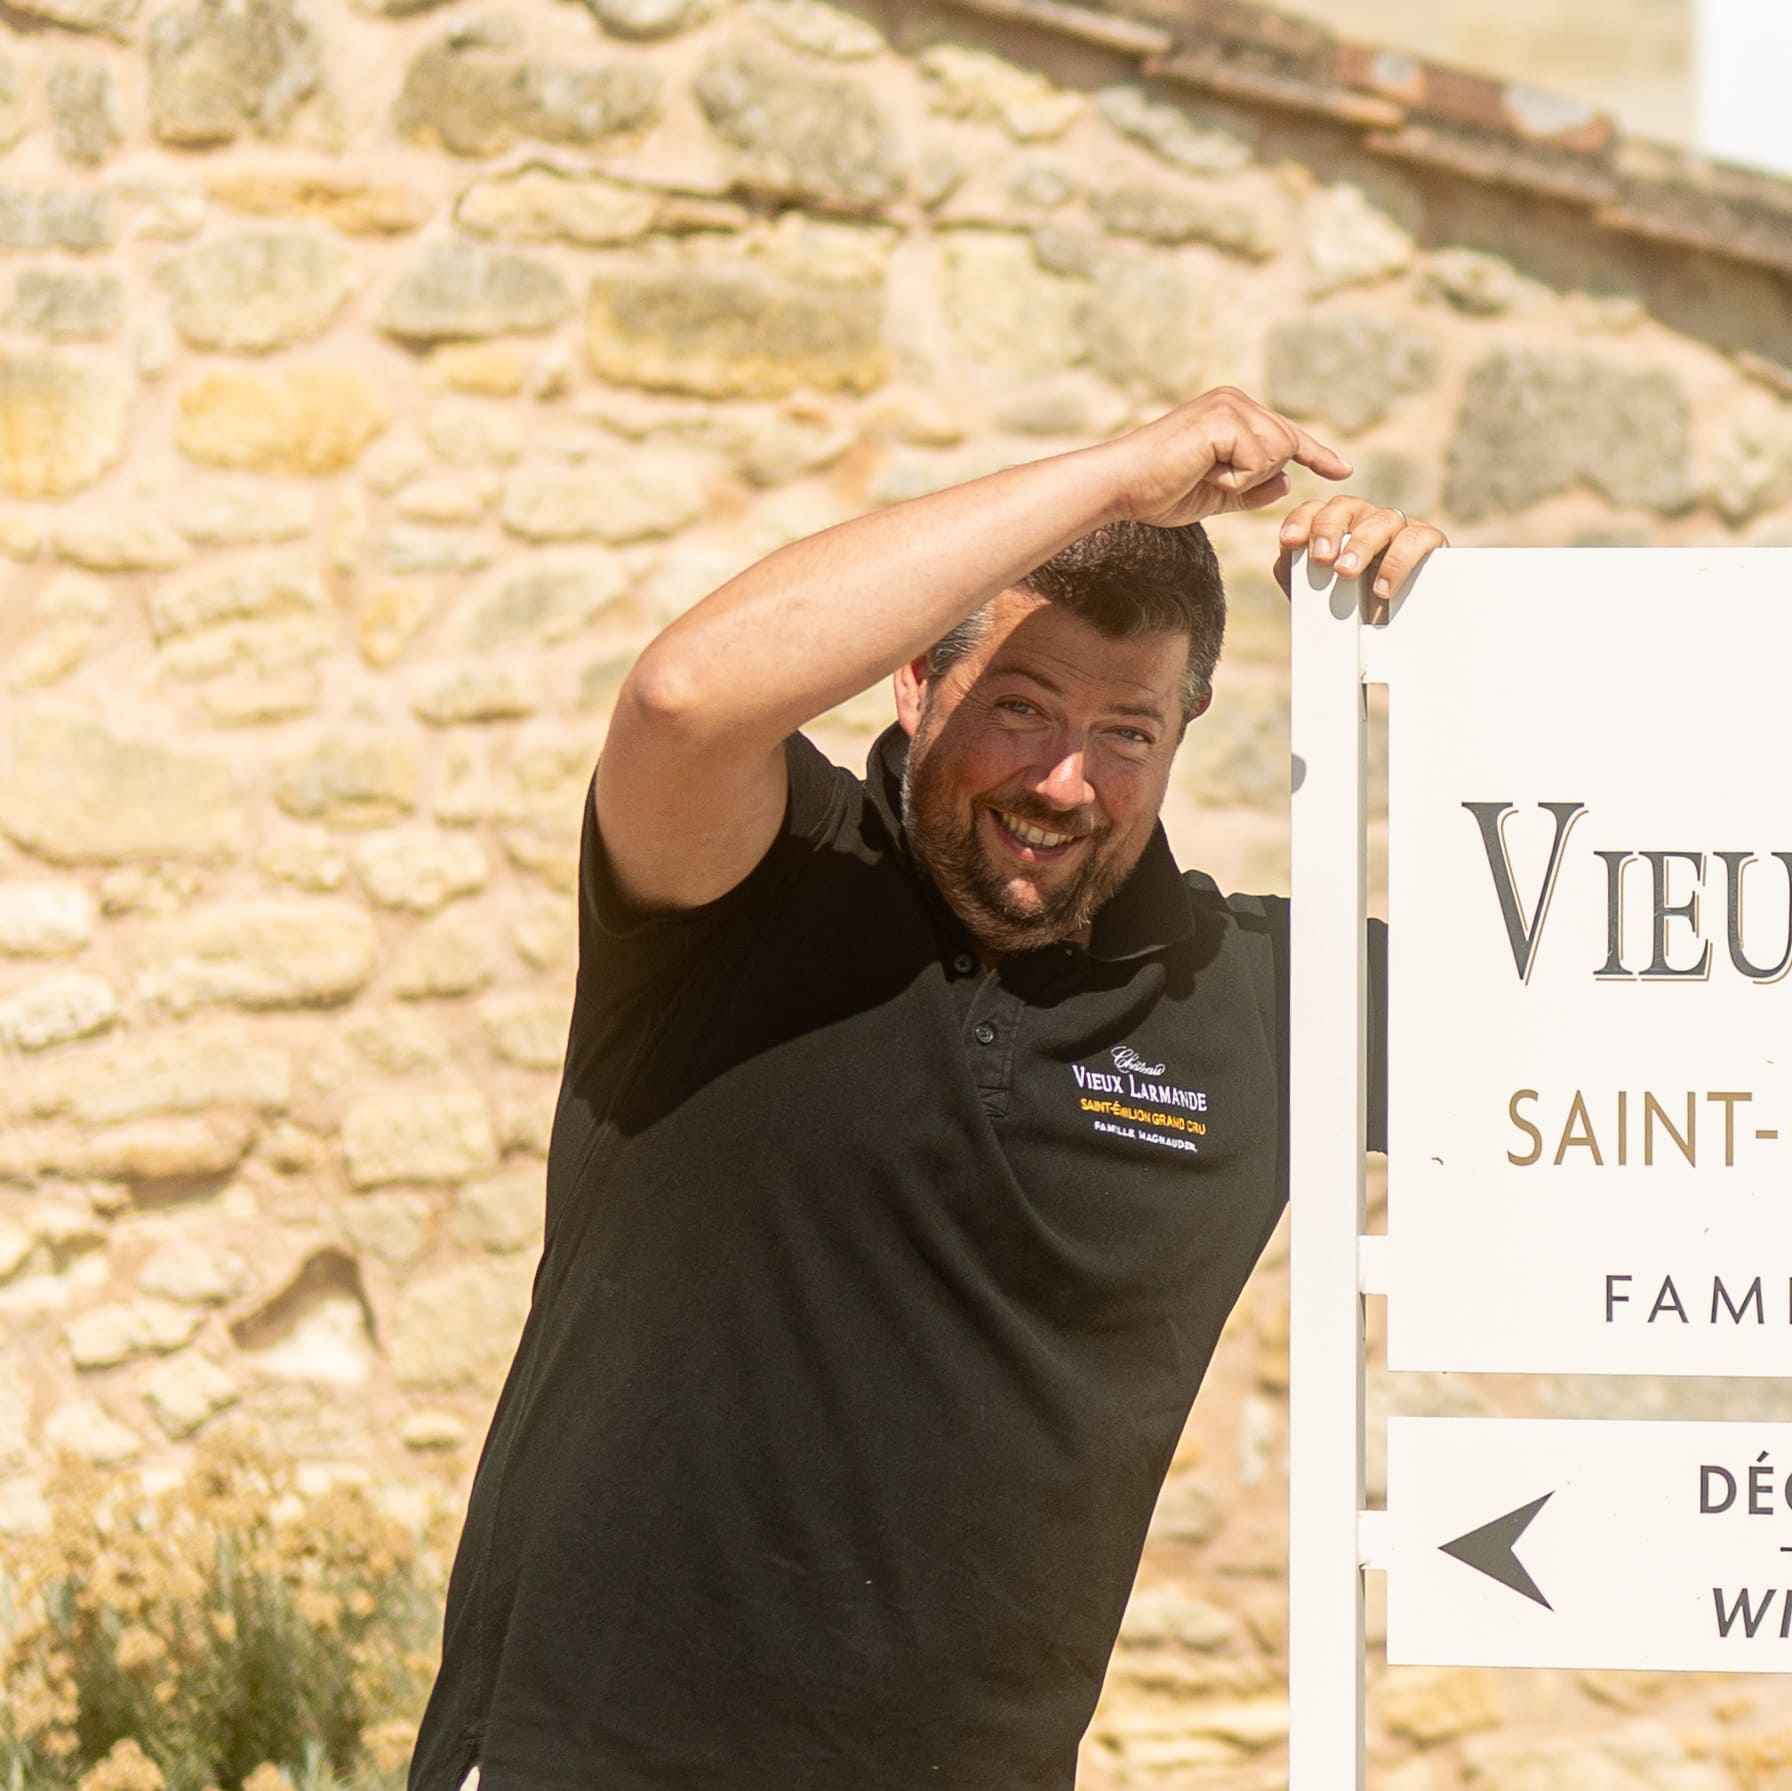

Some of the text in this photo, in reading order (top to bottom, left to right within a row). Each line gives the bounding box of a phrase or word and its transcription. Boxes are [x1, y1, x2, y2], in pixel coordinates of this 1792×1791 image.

[1072, 1064, 1208, 1112] VIEUX LARMANDE
[1151, 1112, 1185, 1131] GRAND
[1187, 1119, 1207, 1136] CRU
